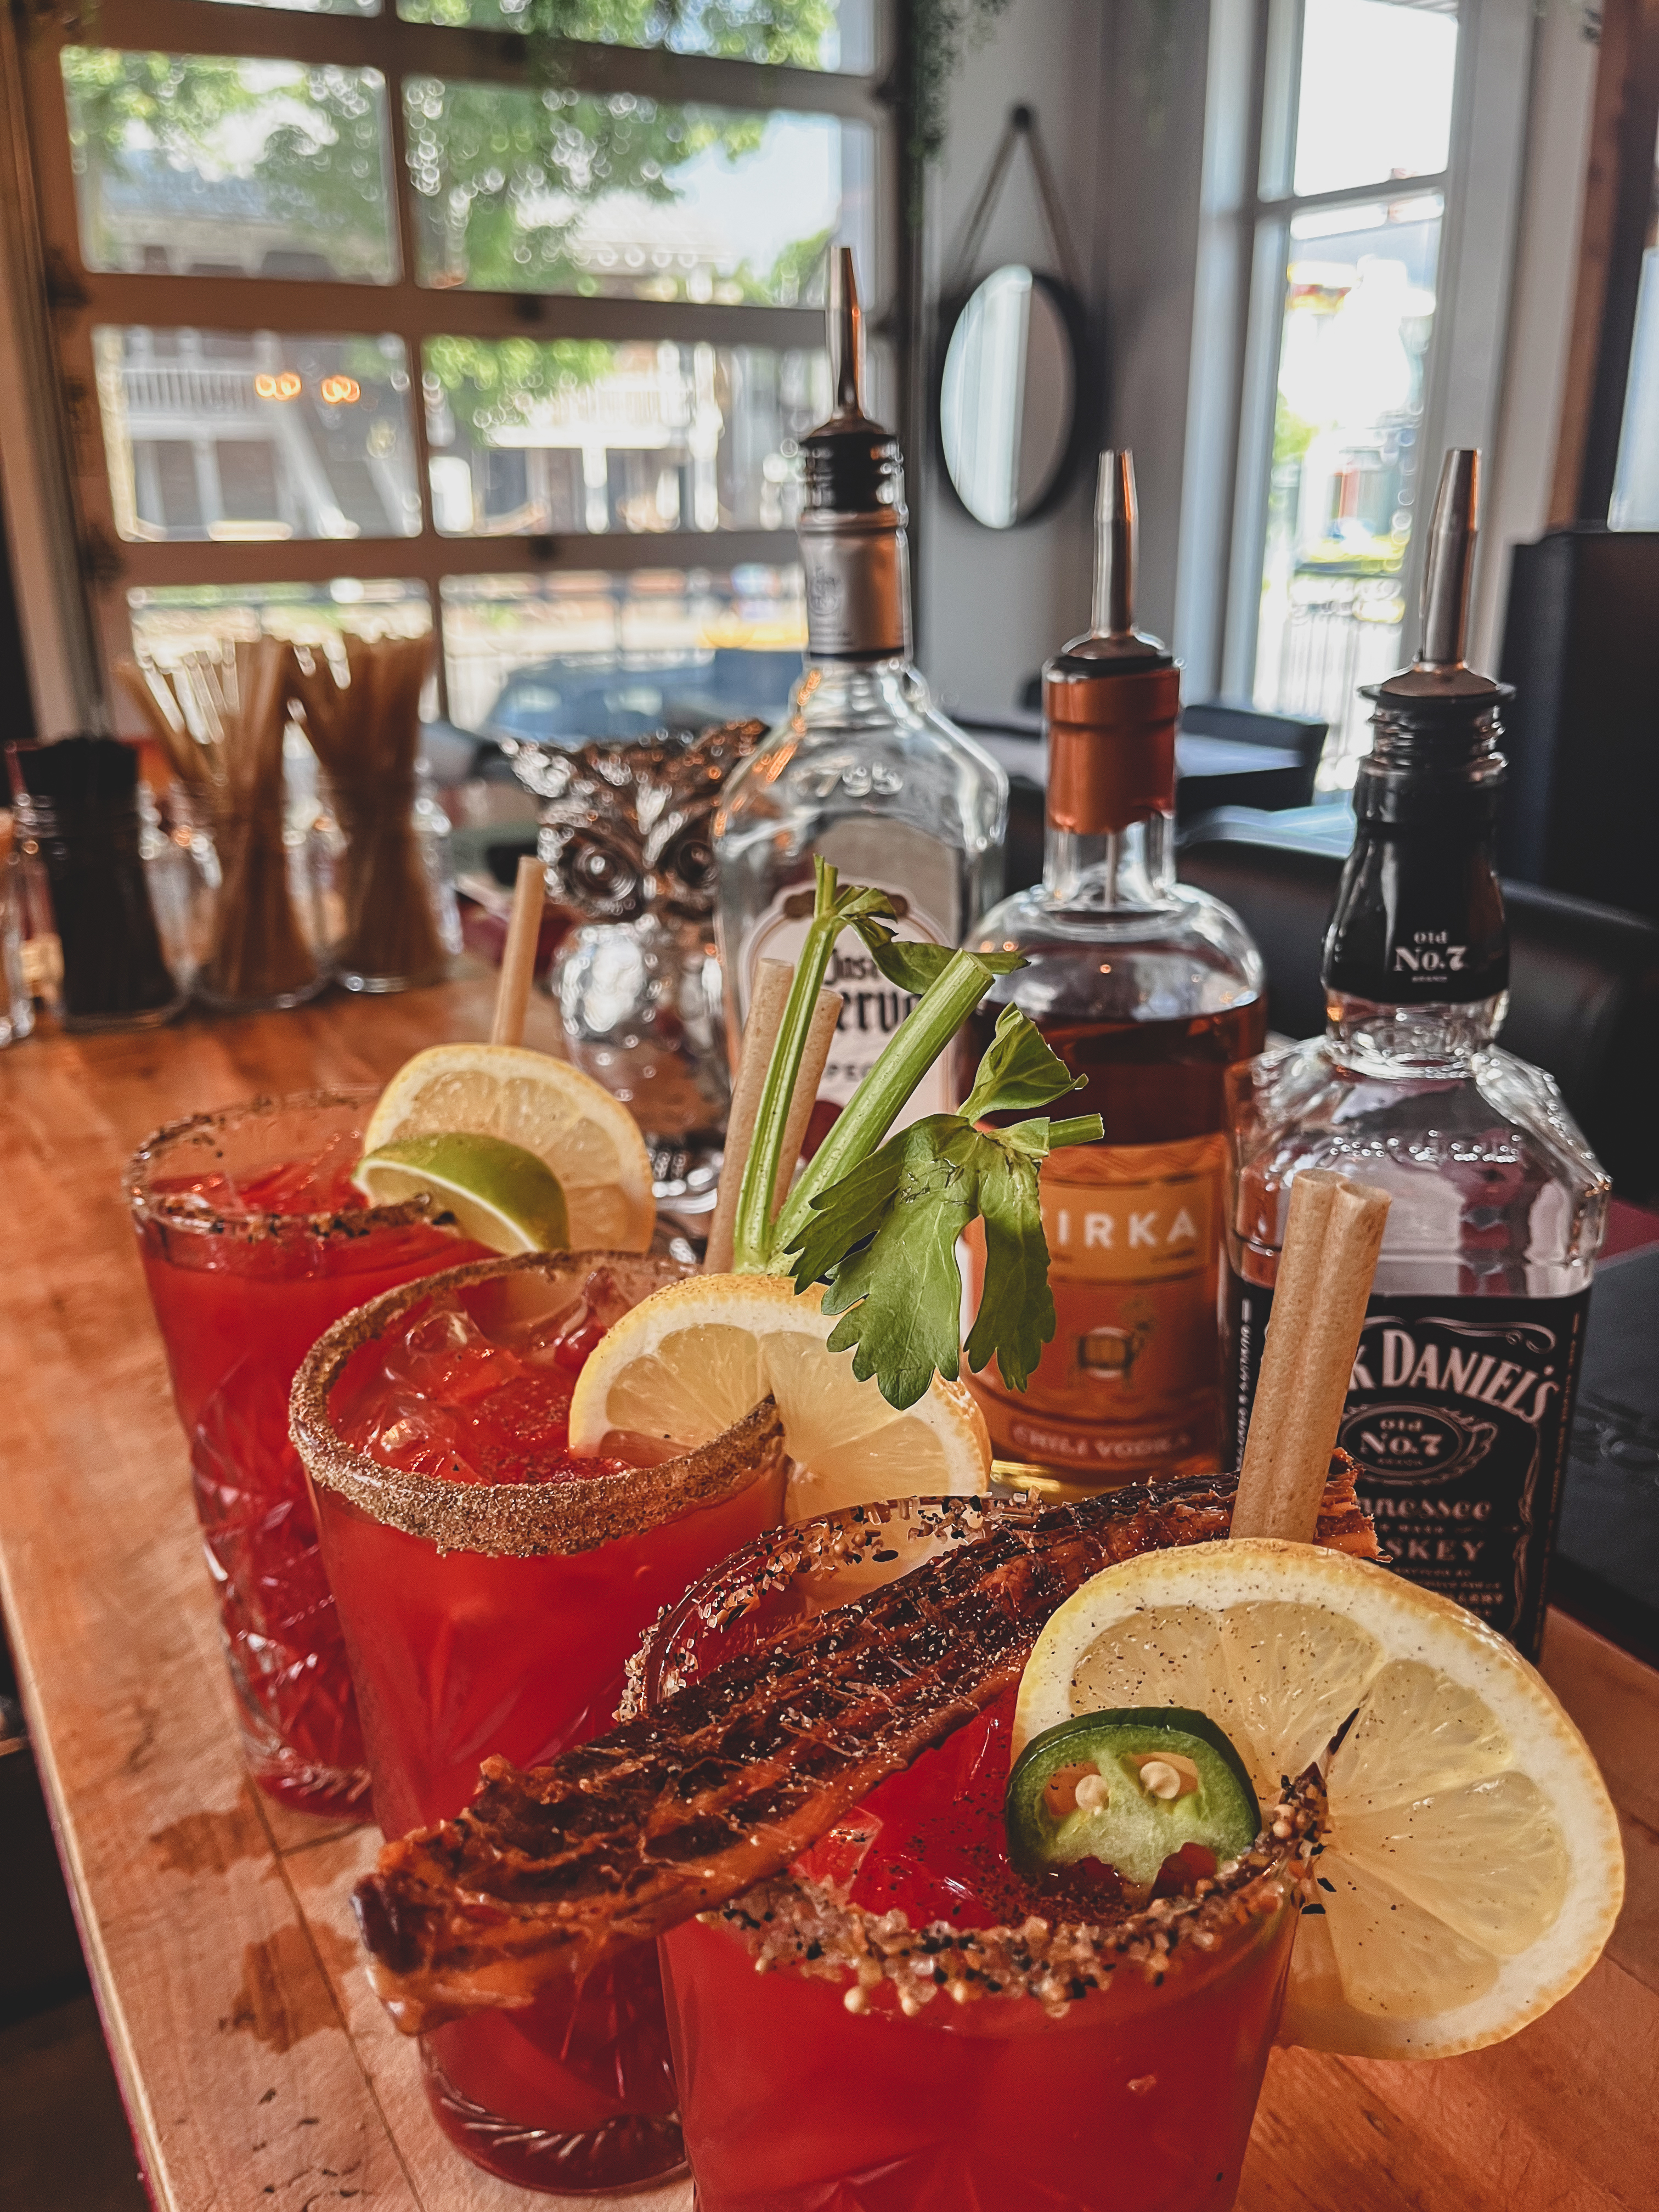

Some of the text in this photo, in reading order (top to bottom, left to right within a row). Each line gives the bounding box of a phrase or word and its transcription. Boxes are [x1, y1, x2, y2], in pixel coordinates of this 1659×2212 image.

[1057, 1207, 1198, 1250] IRKA
[1381, 1328, 1560, 1424] DANIEL'S
[1357, 1497, 1493, 1522] nnessee
[1385, 1538, 1485, 1562] SKEY
